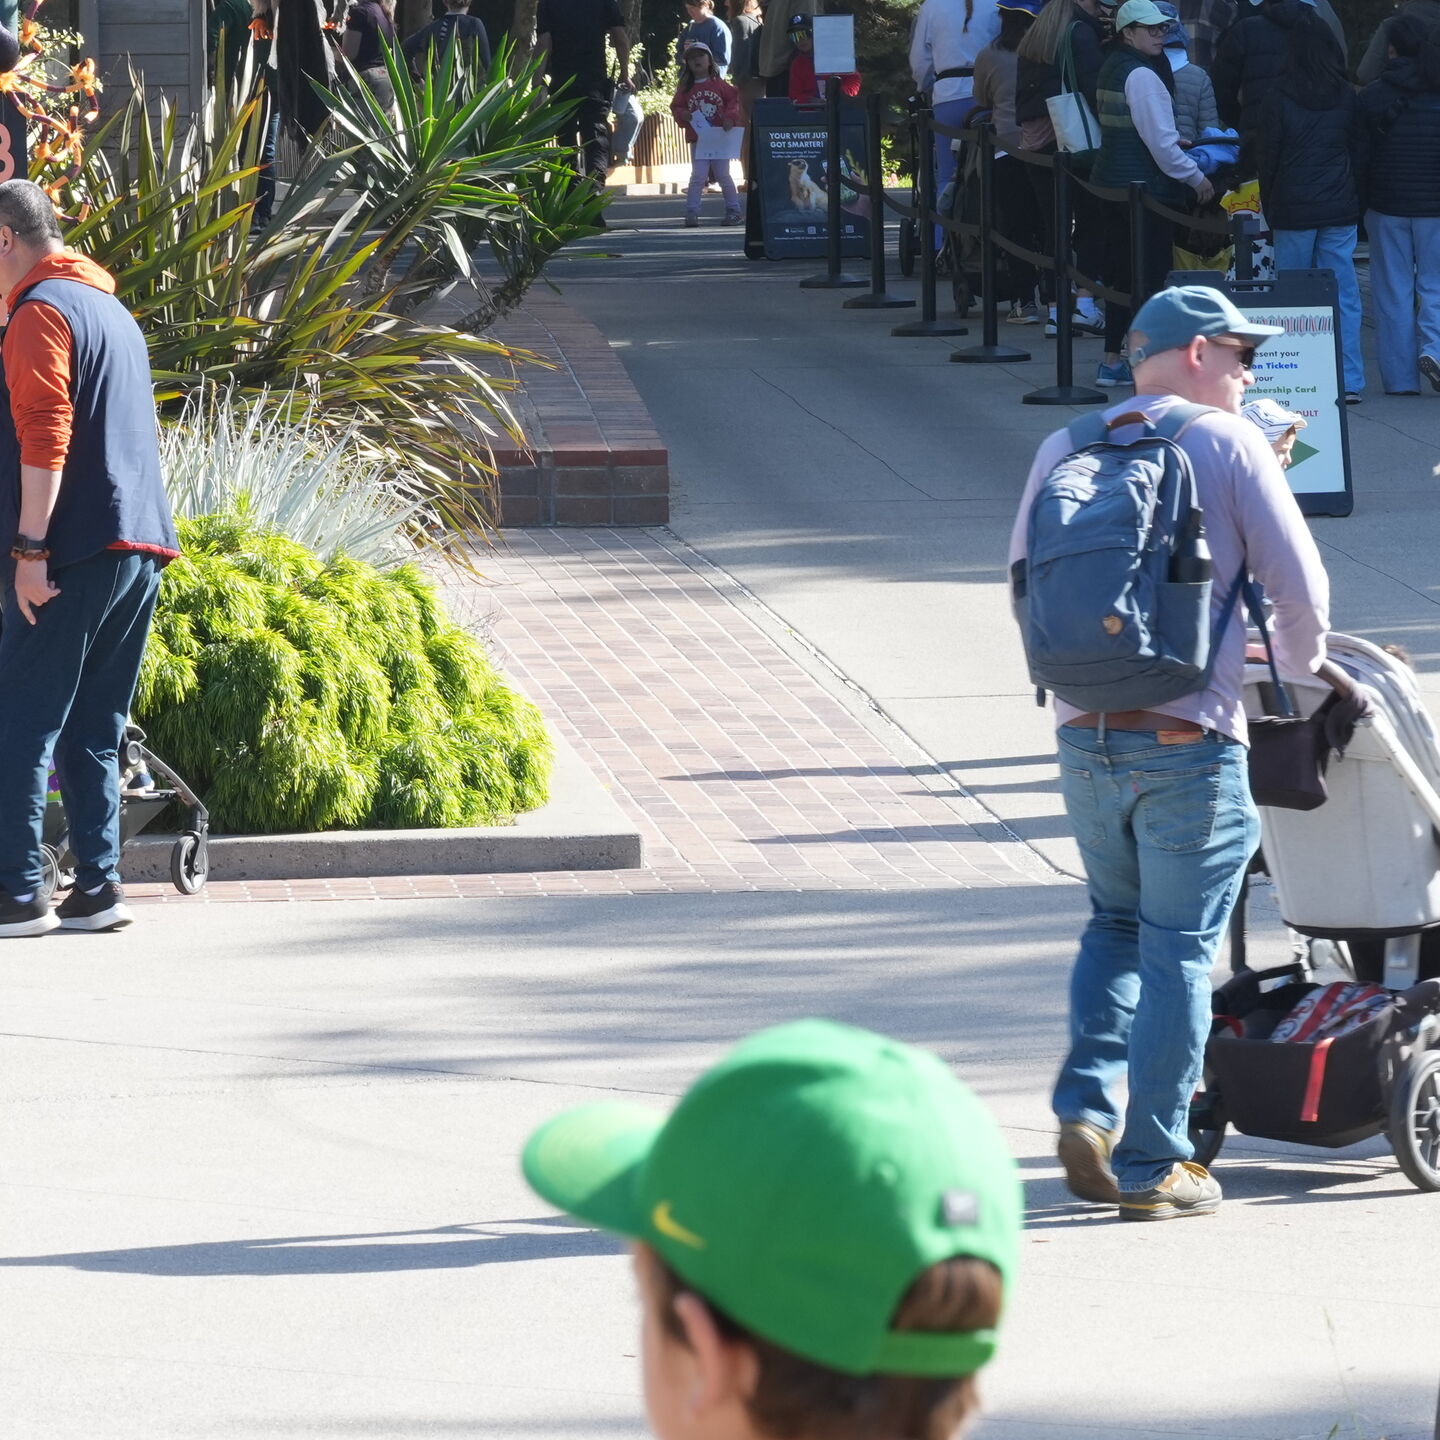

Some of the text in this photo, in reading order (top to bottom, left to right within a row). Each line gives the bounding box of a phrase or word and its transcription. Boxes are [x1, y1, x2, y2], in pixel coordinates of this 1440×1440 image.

[769, 131, 791, 140] YOUR
[791, 131, 811, 139] VISIT
[1280, 351, 1300, 359] your
[1266, 361, 1298, 369] Tickets
[1244, 385, 1317, 395] embership Card
